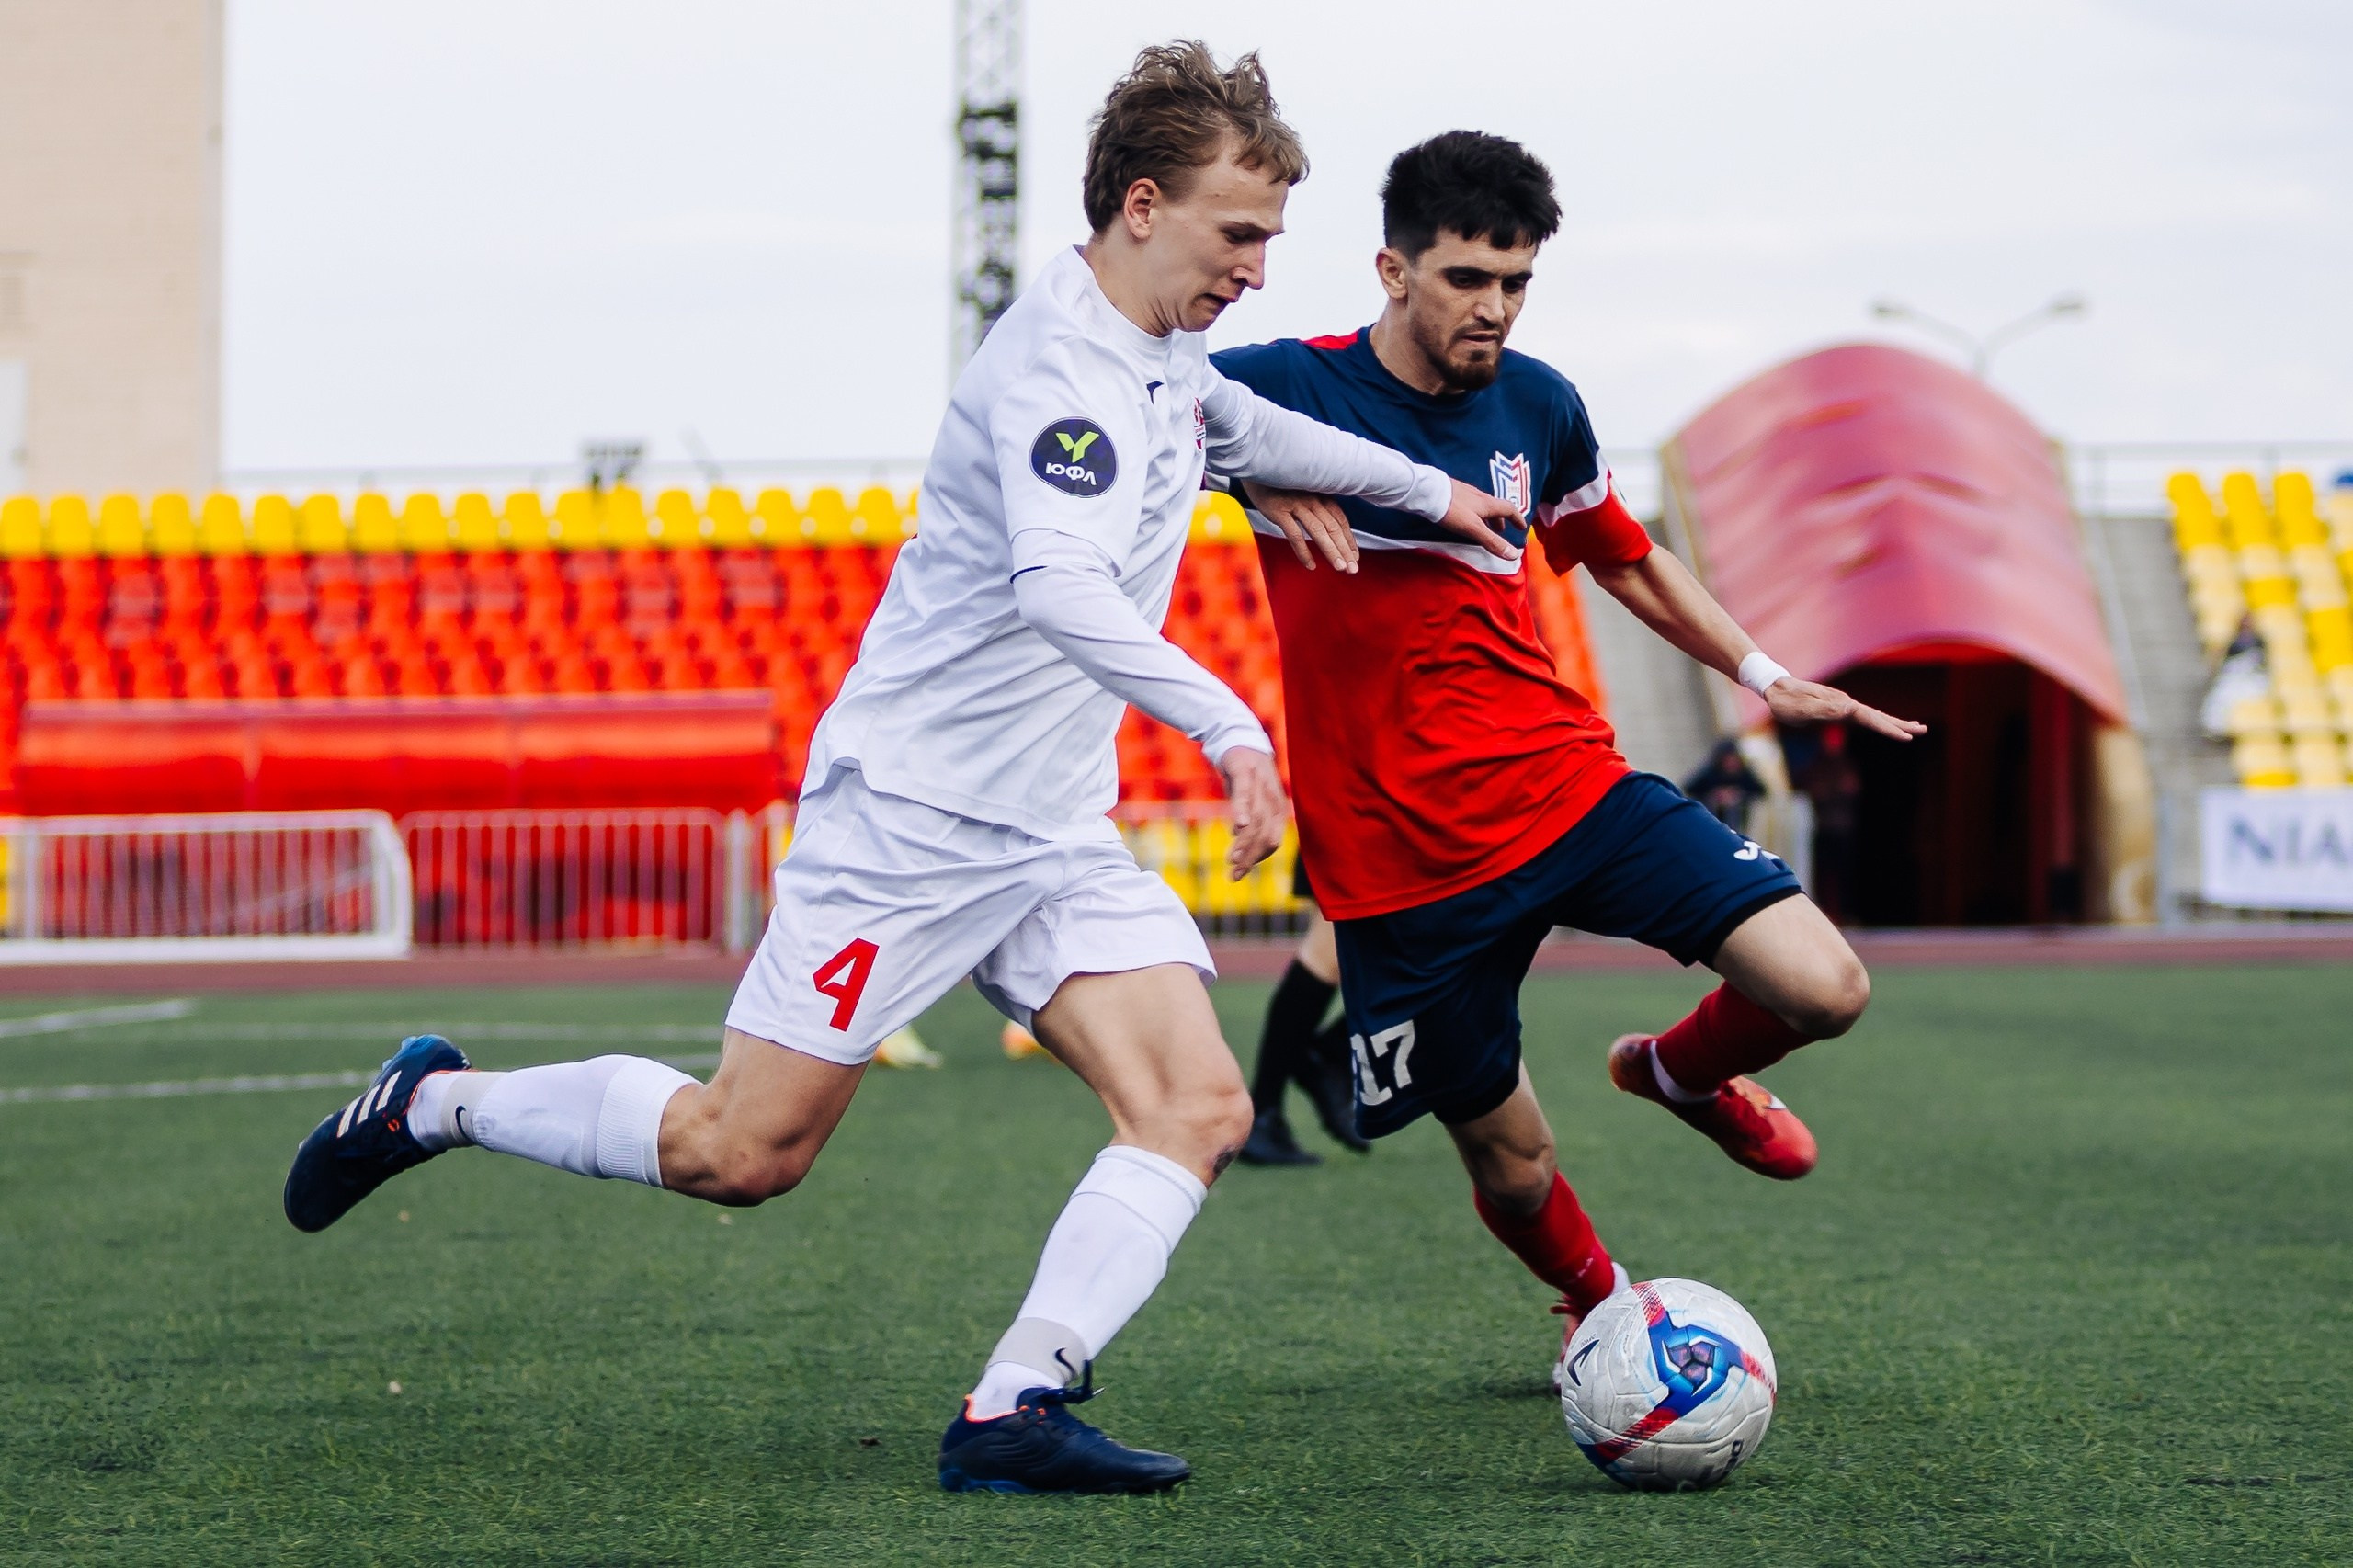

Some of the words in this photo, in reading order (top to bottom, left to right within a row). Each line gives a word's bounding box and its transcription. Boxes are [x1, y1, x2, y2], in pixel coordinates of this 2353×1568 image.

[1045, 462, 1097, 486] ЮФЛ
[812, 937, 880, 1032] 4
[1349, 1018, 1415, 1106] 17
